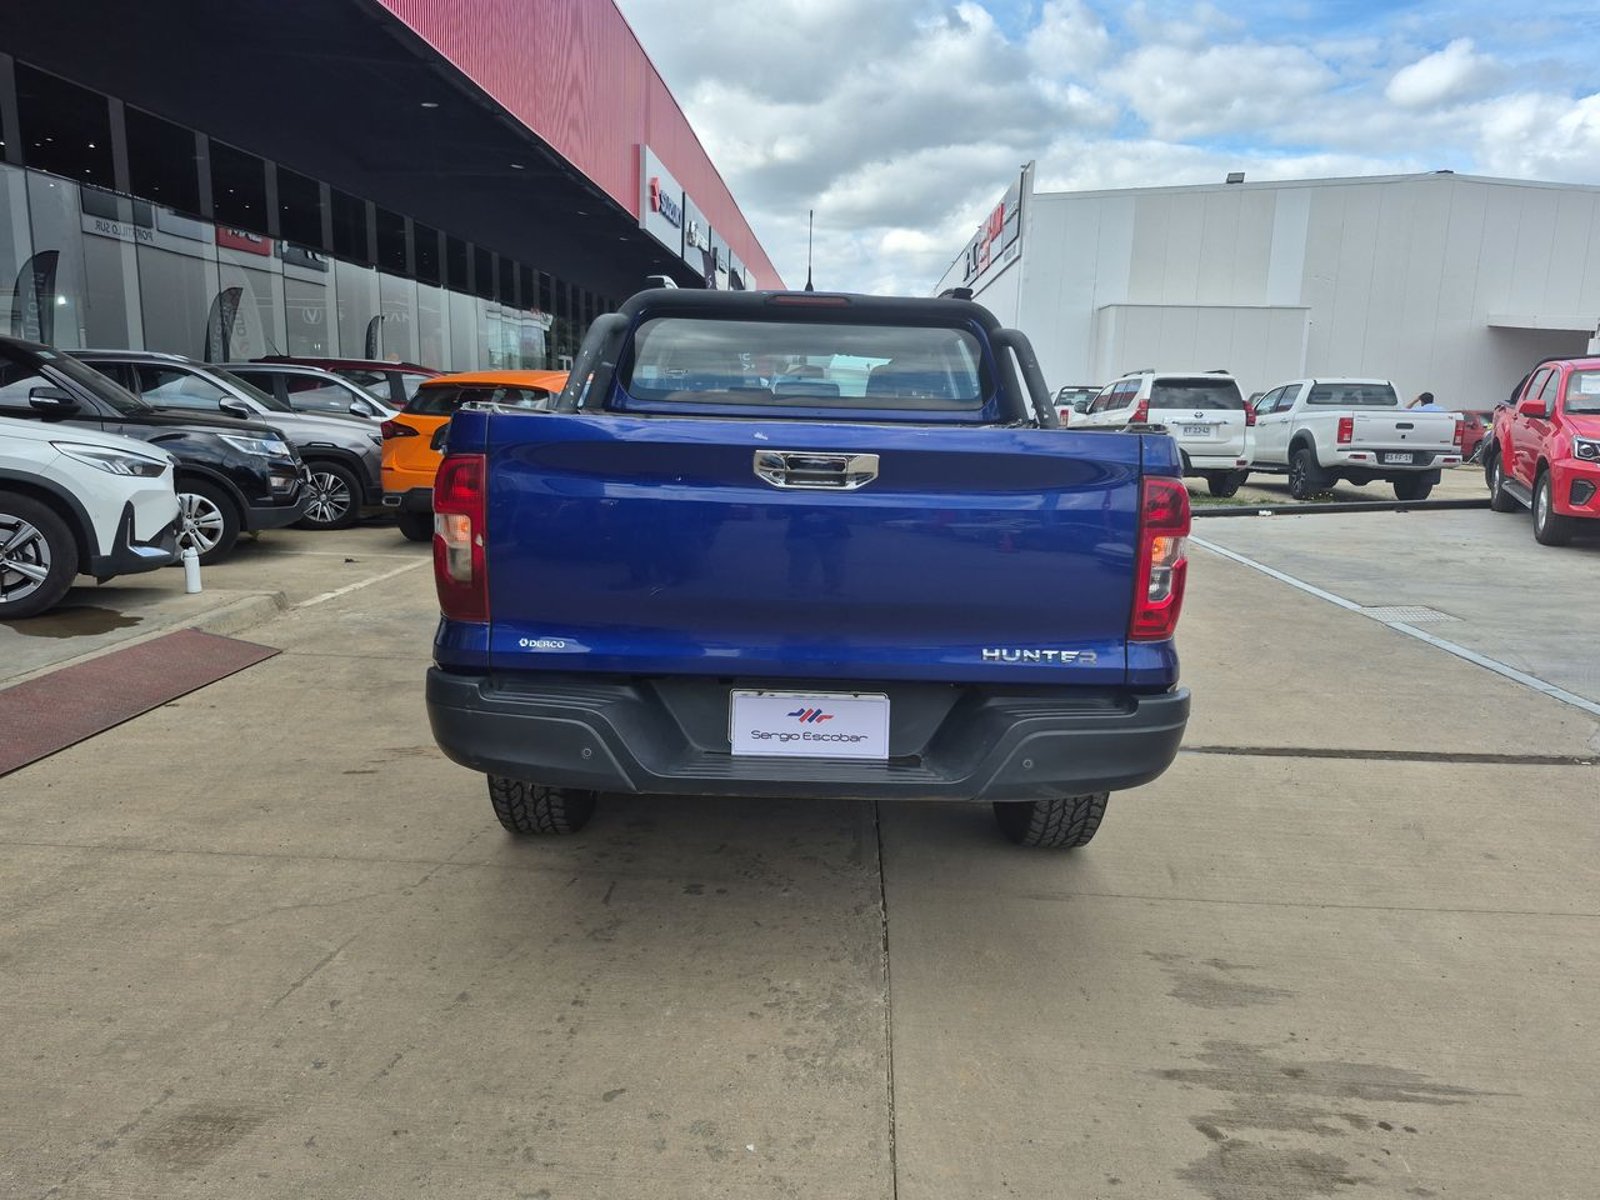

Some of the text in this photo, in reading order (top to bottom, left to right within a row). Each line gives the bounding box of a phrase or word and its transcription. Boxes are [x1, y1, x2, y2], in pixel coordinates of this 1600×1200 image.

[528, 639, 565, 649] DERCO
[982, 648, 1098, 664] HUNTER
[802, 731, 869, 743] Escobar
